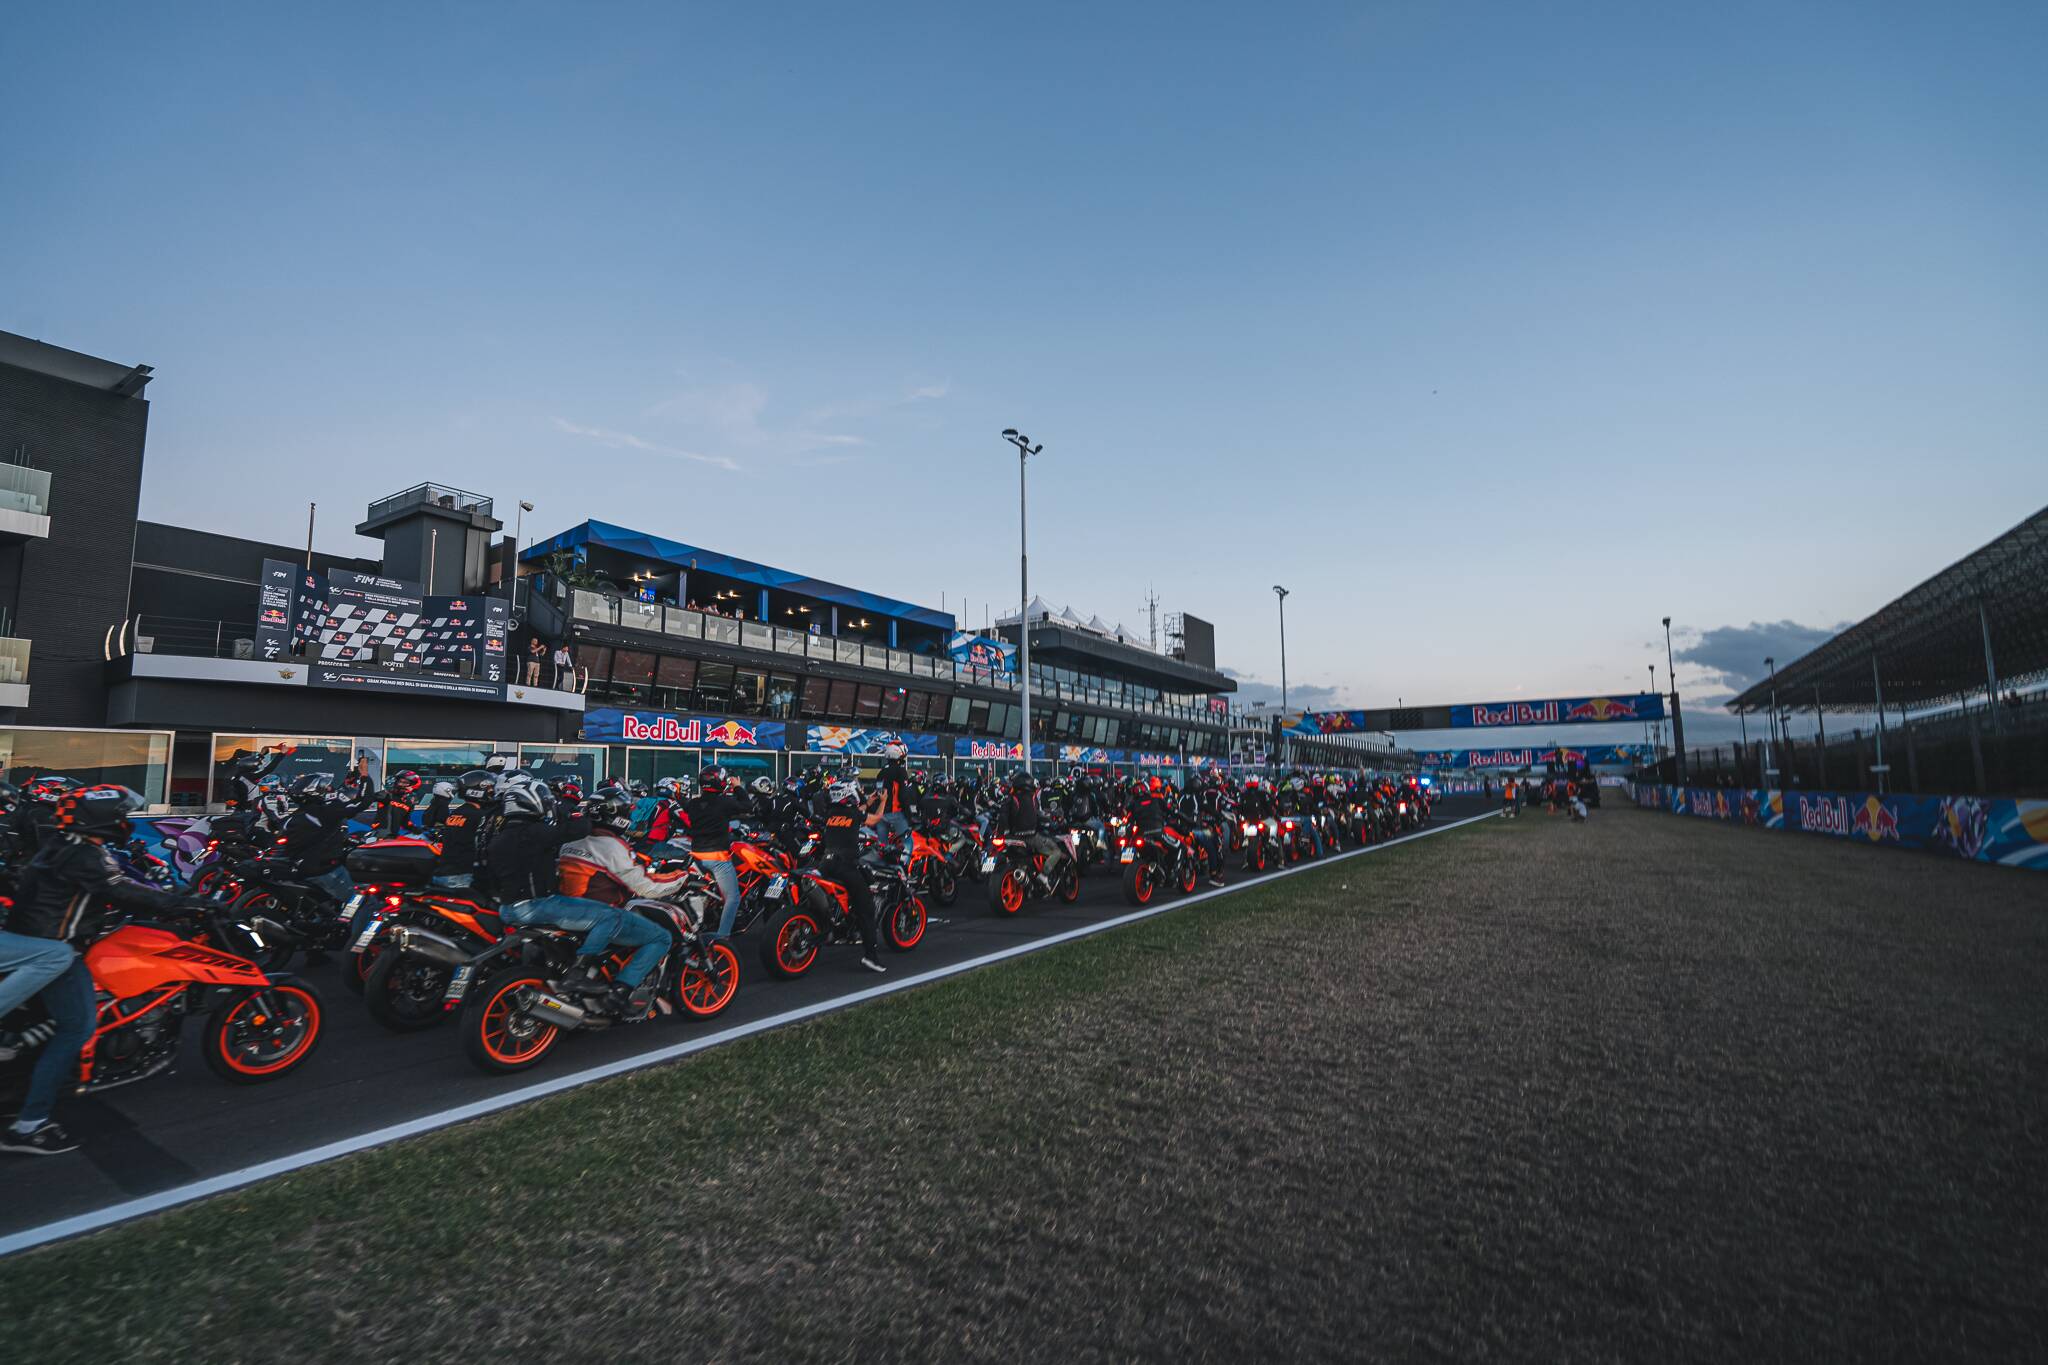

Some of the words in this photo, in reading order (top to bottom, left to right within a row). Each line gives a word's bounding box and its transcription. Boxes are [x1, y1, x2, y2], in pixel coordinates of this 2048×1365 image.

[353, 575, 375, 584] FIM
[488, 671, 500, 681] 75
[1473, 704, 1515, 726] Red
[1516, 701, 1559, 723] Bull
[623, 715, 664, 740] Red
[664, 719, 700, 743] Bull
[972, 741, 990, 758] Red
[990, 743, 1006, 759] Bull
[1469, 751, 1500, 767] Red
[1501, 750, 1532, 766] Bull
[826, 816, 853, 828] KTM
[1800, 796, 1823, 831] Red
[1823, 796, 1848, 835] Bull
